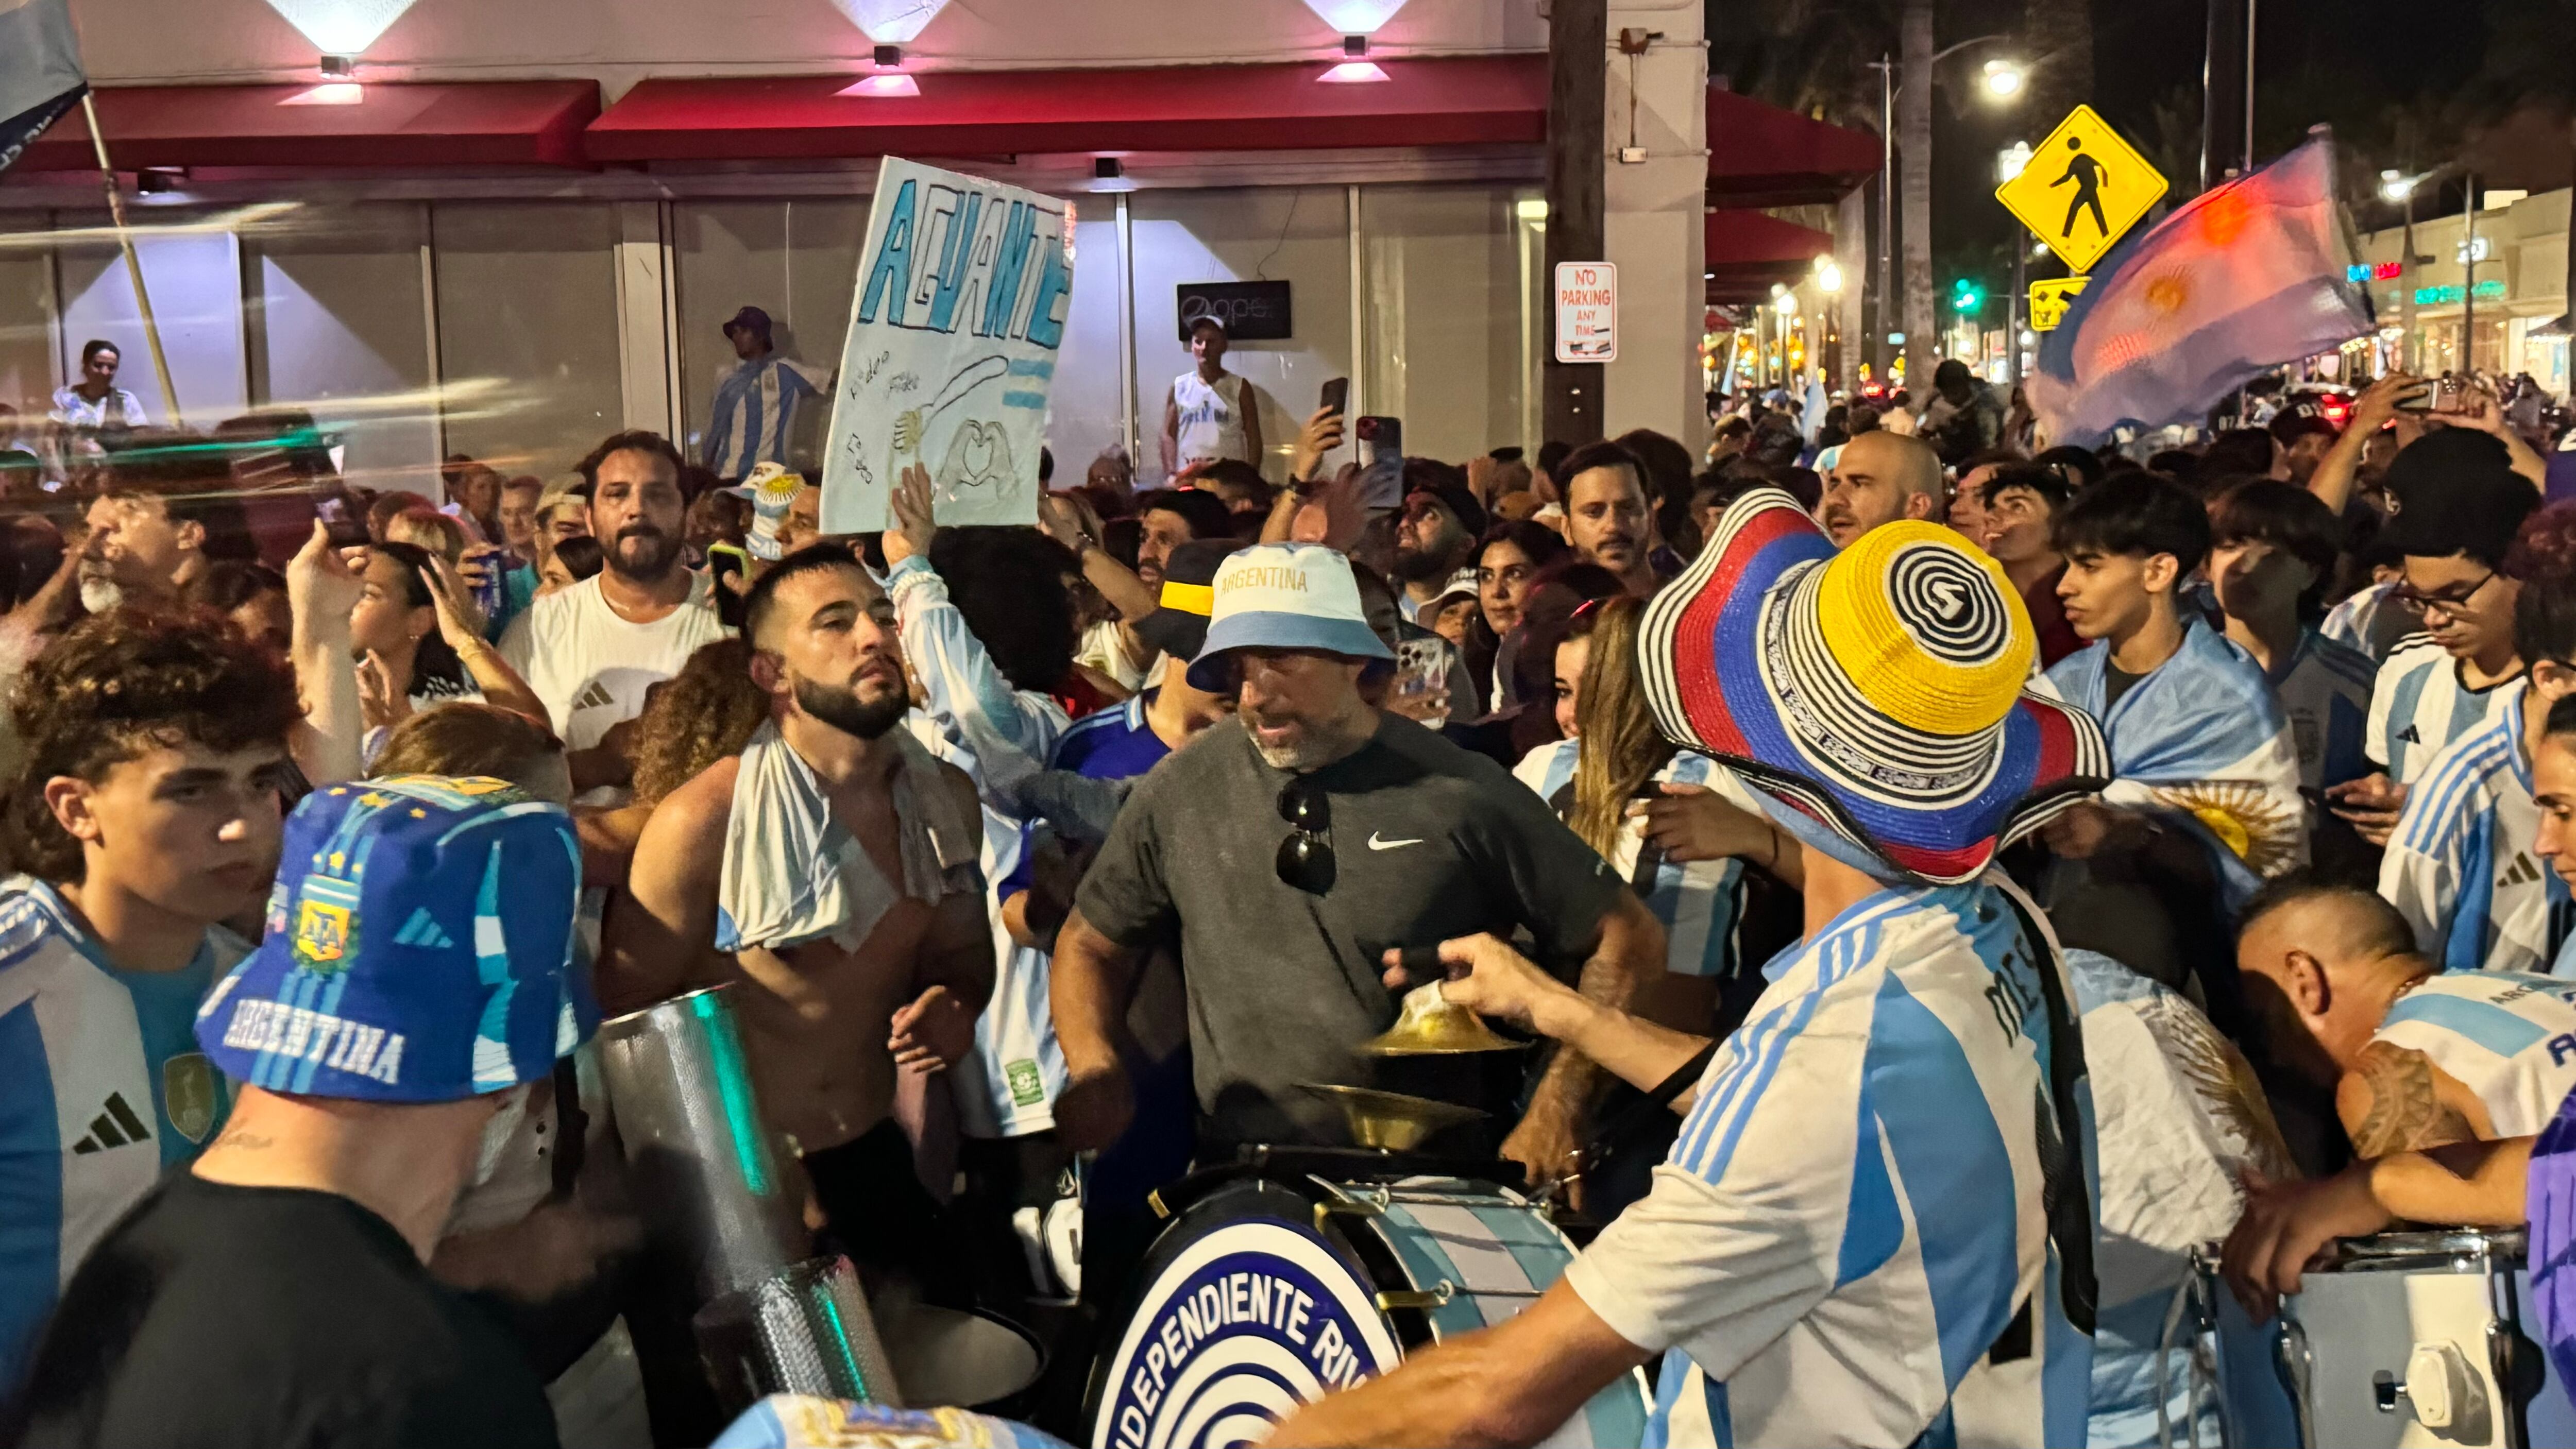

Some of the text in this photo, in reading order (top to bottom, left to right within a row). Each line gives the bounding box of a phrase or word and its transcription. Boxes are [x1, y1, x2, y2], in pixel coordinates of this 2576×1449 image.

[857, 178, 1072, 349] AGUANTE
[1575, 269, 1597, 286] NO
[1562, 289, 1611, 306] PARKING
[1577, 310, 1597, 321] ANY
[1575, 325, 1596, 336] TIME
[1221, 567, 1308, 596] ARGENTINA
[223, 998, 405, 1085] ARGENTINA
